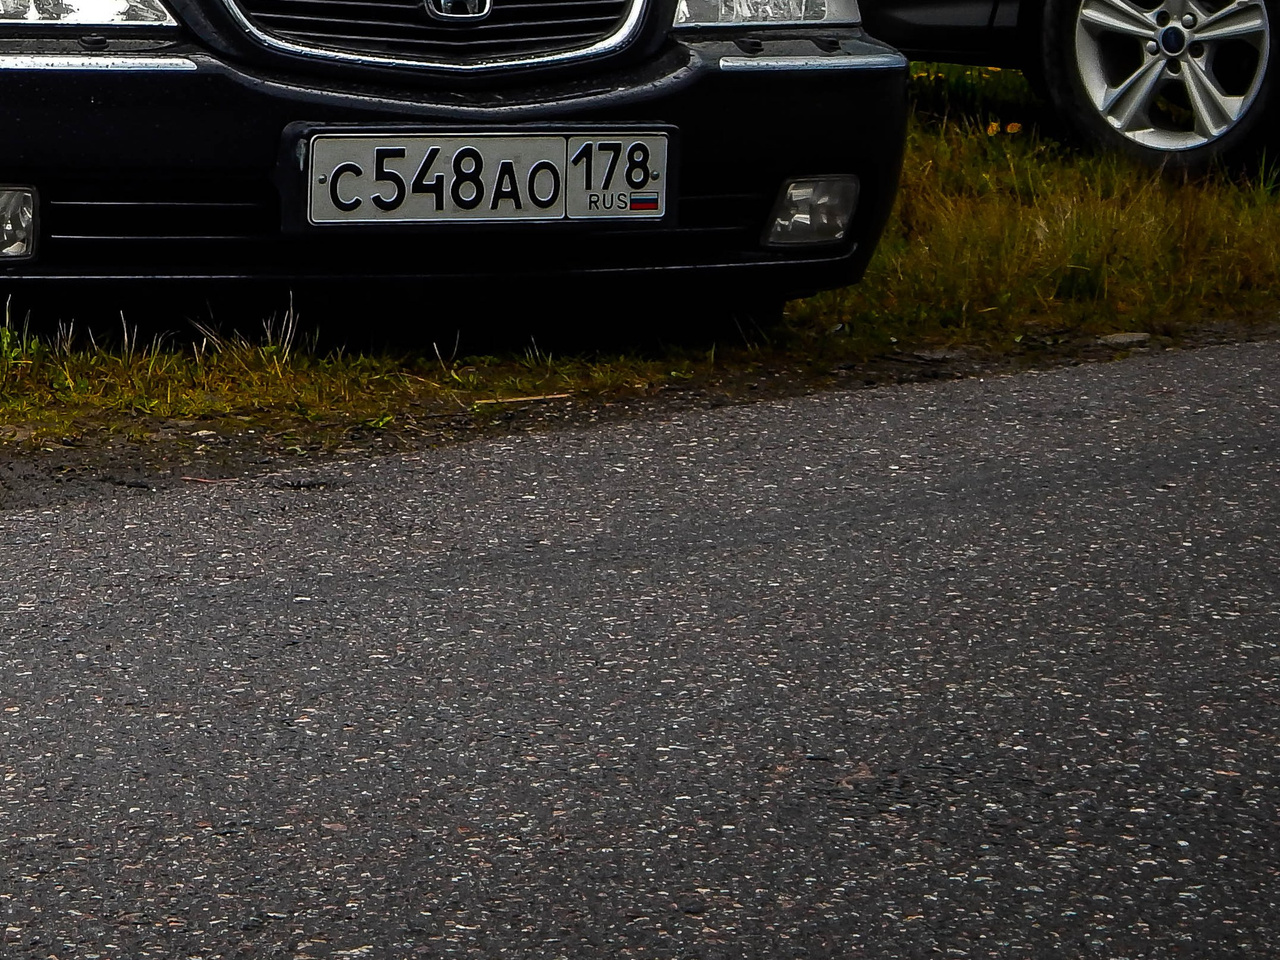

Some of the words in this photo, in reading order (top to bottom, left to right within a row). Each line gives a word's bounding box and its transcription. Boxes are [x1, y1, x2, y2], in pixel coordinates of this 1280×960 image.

[329, 145, 561, 212] С548АО
[570, 141, 650, 191] 178
[588, 193, 628, 211] RUS
